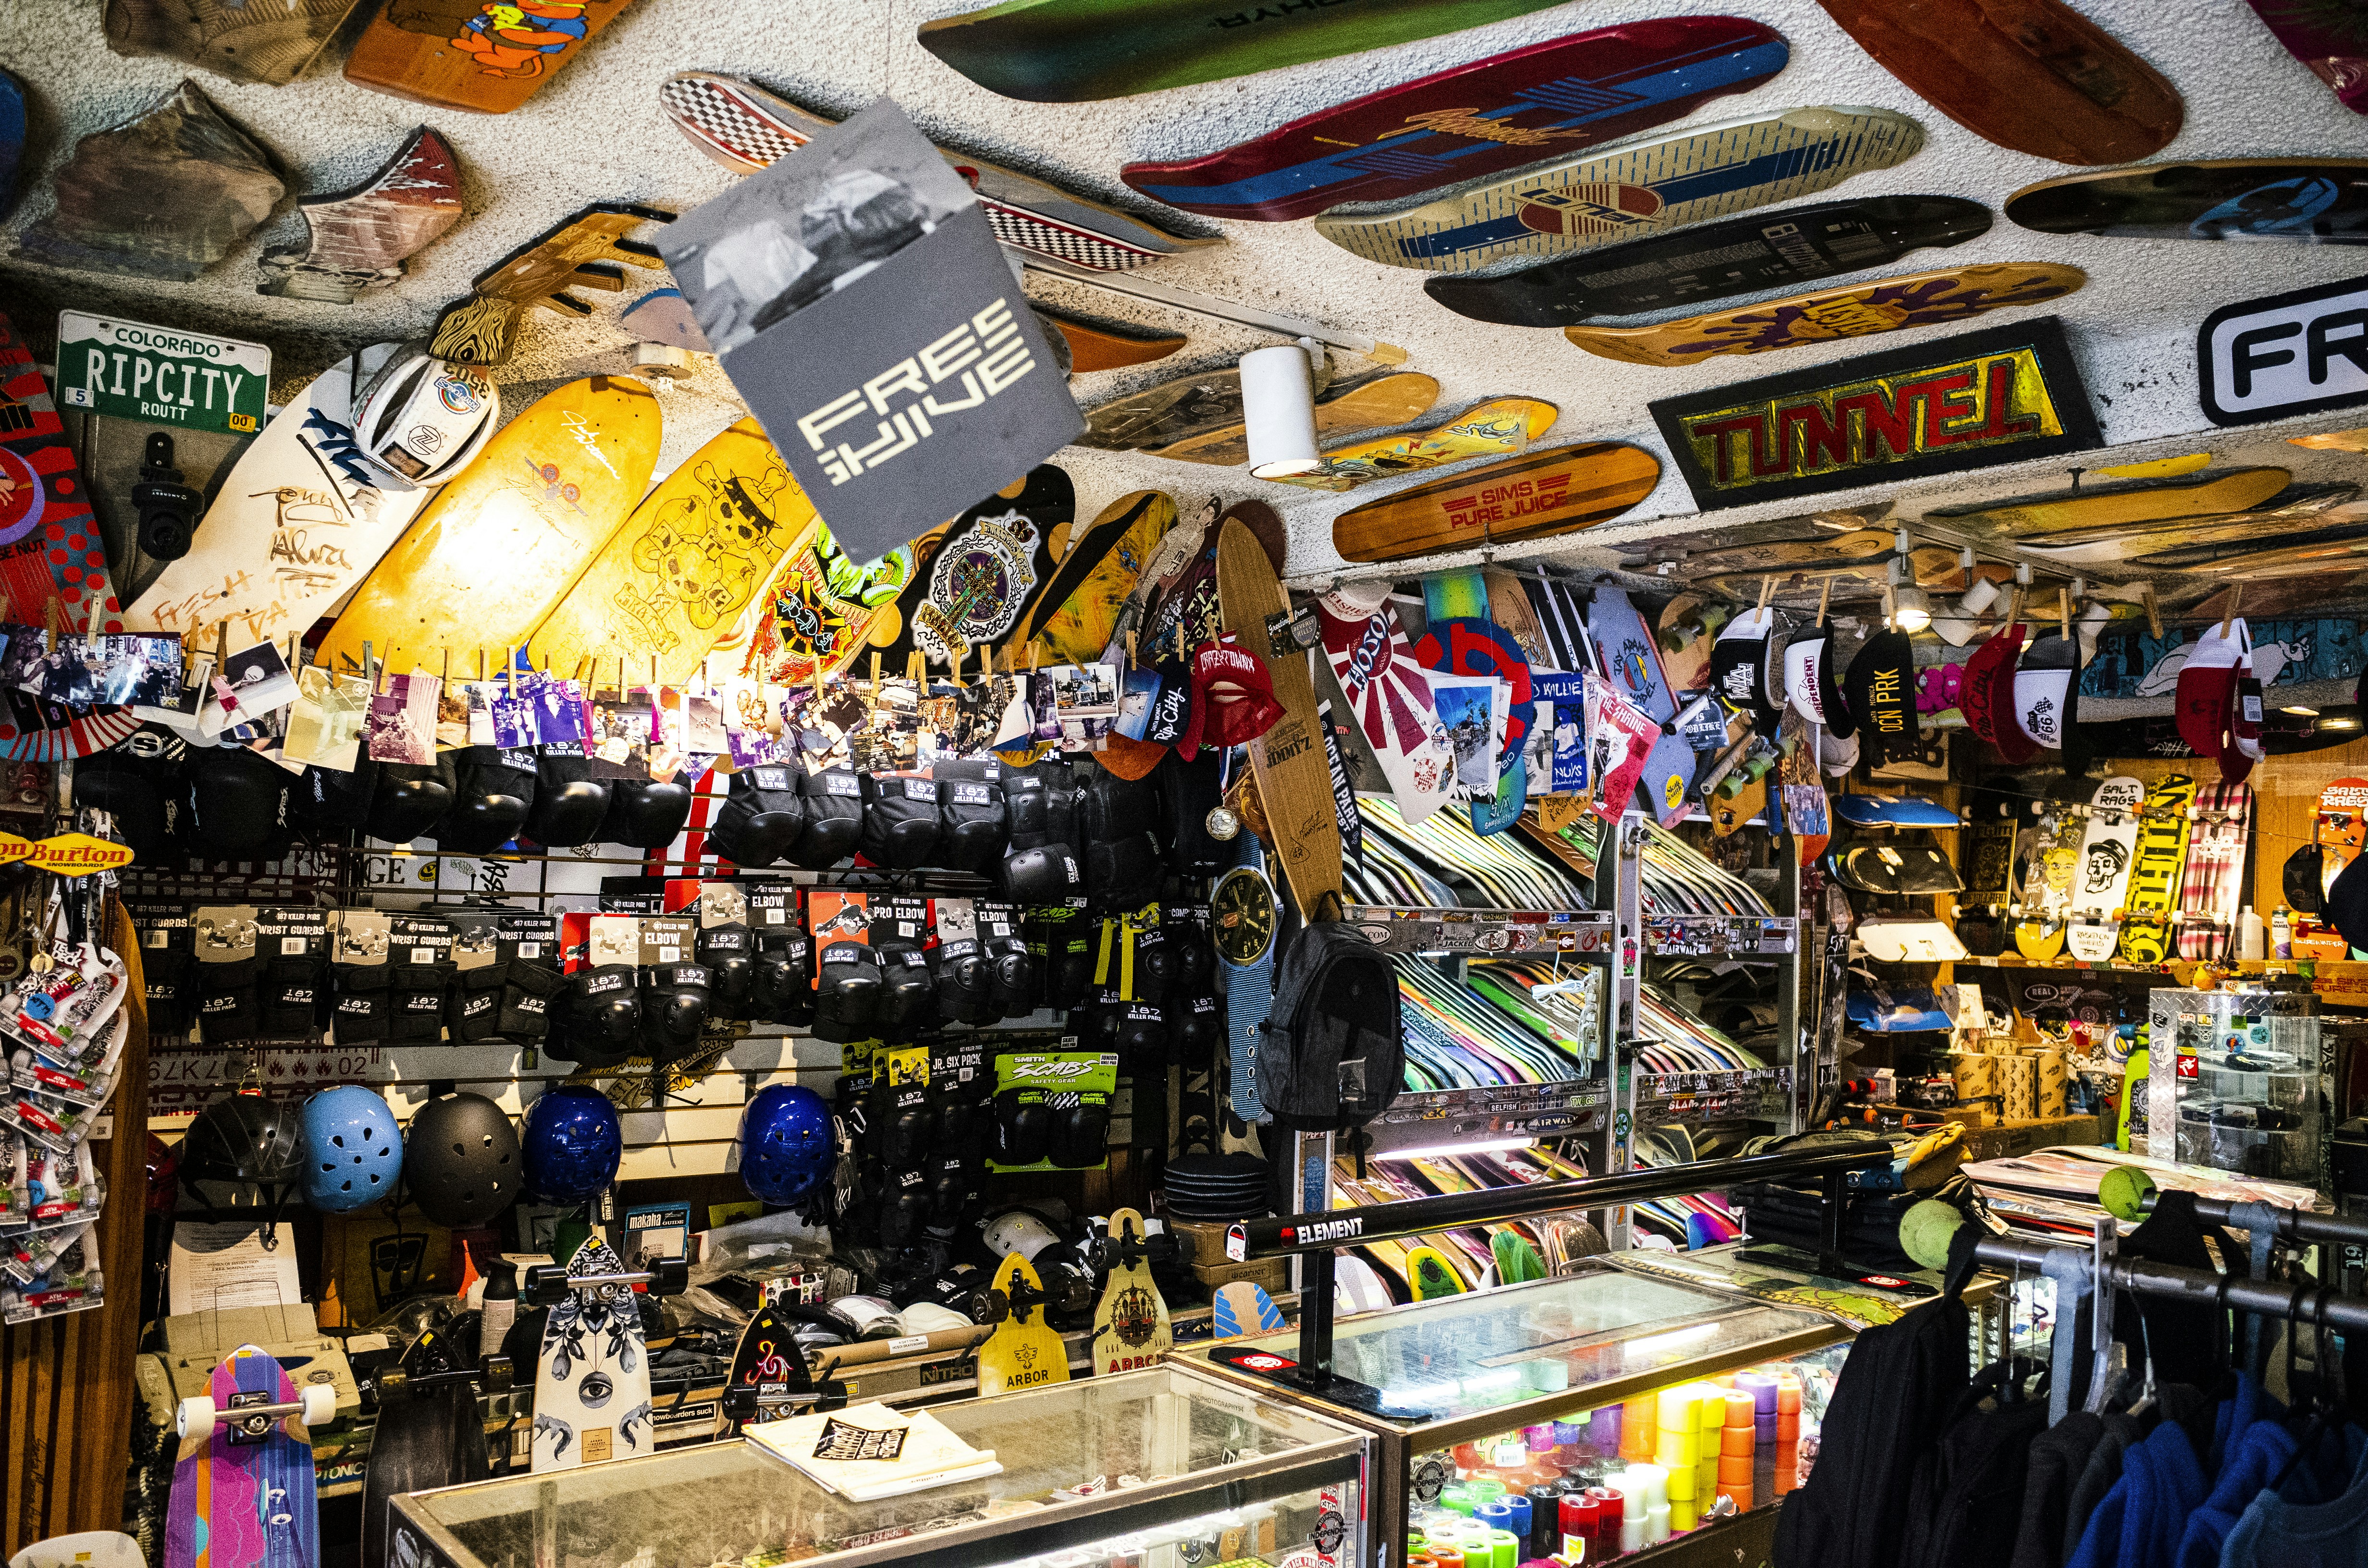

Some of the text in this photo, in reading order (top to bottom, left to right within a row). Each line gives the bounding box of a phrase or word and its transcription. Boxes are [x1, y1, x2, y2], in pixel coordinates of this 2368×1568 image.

[115, 327, 220, 358] COLORADO
[86, 348, 243, 413] RIPCITY
[75, 390, 86, 403] 5
[141, 401, 187, 420] ROUTT
[232, 414, 248, 427] 00
[1692, 357, 2041, 488] TUNNEL
[1481, 481, 1533, 505] SIMS
[1451, 490, 1568, 529] PURE JUICE
[1294, 606, 1308, 621] from
[1293, 619, 1317, 634] BEVERLY
[1296, 627, 1314, 638] HILLS
[1542, 681, 1583, 697] WILLIE
[1805, 656, 1823, 719] INDEPENDENT
[1599, 695, 1616, 713] THE
[1875, 668, 1903, 733] OCN PRK
[1154, 702, 1162, 720] MONICA
[1154, 686, 1183, 742] Rip City
[1614, 706, 1648, 737] SHRINE
[505, 747, 534, 766] 187
[1322, 734, 1359, 830] OCEAN PARK
[956, 784, 987, 796] 187
[2103, 784, 2138, 794] SALT
[2099, 795, 2137, 807] RAGS
[28, 844, 125, 863] Burton
[752, 895, 784, 907] ELBOW
[874, 907, 925, 919] PRO ELBOW
[979, 912, 1007, 923] ELBOW
[155, 919, 187, 927] GUARDS
[258, 925, 326, 937] WRIST GUARDS
[499, 931, 555, 940] WRIST GUARDS
[2097, 931, 2109, 940] ON
[390, 935, 453, 946] WRIST GUARDS
[645, 932, 680, 944] ELBOW
[711, 934, 739, 944] 187
[1443, 940, 1473, 948] JACKED
[945, 942, 973, 953] 187
[1667, 944, 1698, 956] AIRWALK
[51, 950, 81, 968] DECK
[678, 969, 704, 980] 187
[591, 975, 620, 988] 187
[146, 986, 173, 994] 187
[285, 990, 312, 998] 187
[2032, 988, 2051, 996] REAL
[2312, 984, 2350, 992] PURE
[206, 997, 234, 1008] 187
[342, 1000, 370, 1010] 187
[411, 997, 437, 1006] 187
[466, 997, 490, 1011] 187
[521, 998, 545, 1008] 187
[339, 1004, 357, 1013] KILLER
[1130, 1006, 1160, 1016] 187
[933, 1054, 981, 1069] JR. SIX PACK
[899, 1092, 923, 1103] 187
[1491, 1103, 1517, 1112] SELFISH
[629, 1213, 661, 1229] makaha
[1297, 1218, 1363, 1245] ELEMENT
[1006, 1369, 1049, 1388] ARBOR
[653, 1407, 713, 1422] nowboarders suck
[1409, 1475, 1451, 1489] INDEPENDENT
